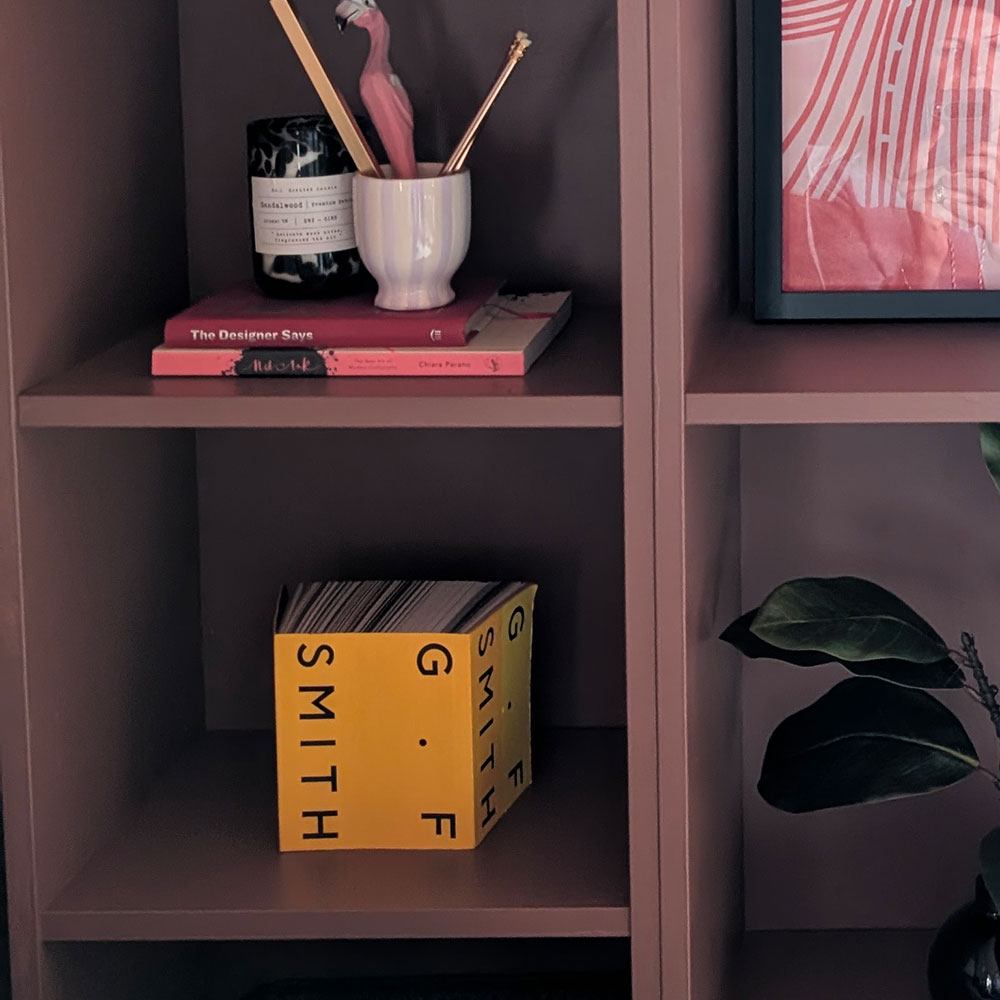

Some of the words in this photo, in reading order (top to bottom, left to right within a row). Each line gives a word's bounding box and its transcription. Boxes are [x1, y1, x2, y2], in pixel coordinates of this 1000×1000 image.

[260, 201, 303, 209] Sandalwood
[190, 329, 216, 340] The
[218, 329, 278, 342] Designer
[281, 329, 313, 342] Says
[508, 605, 525, 641] G
[416, 643, 453, 676] G
[296, 643, 339, 840] SMITH
[478, 626, 496, 829] SMITH
[507, 760, 524, 787] F
[420, 813, 456, 839] F
